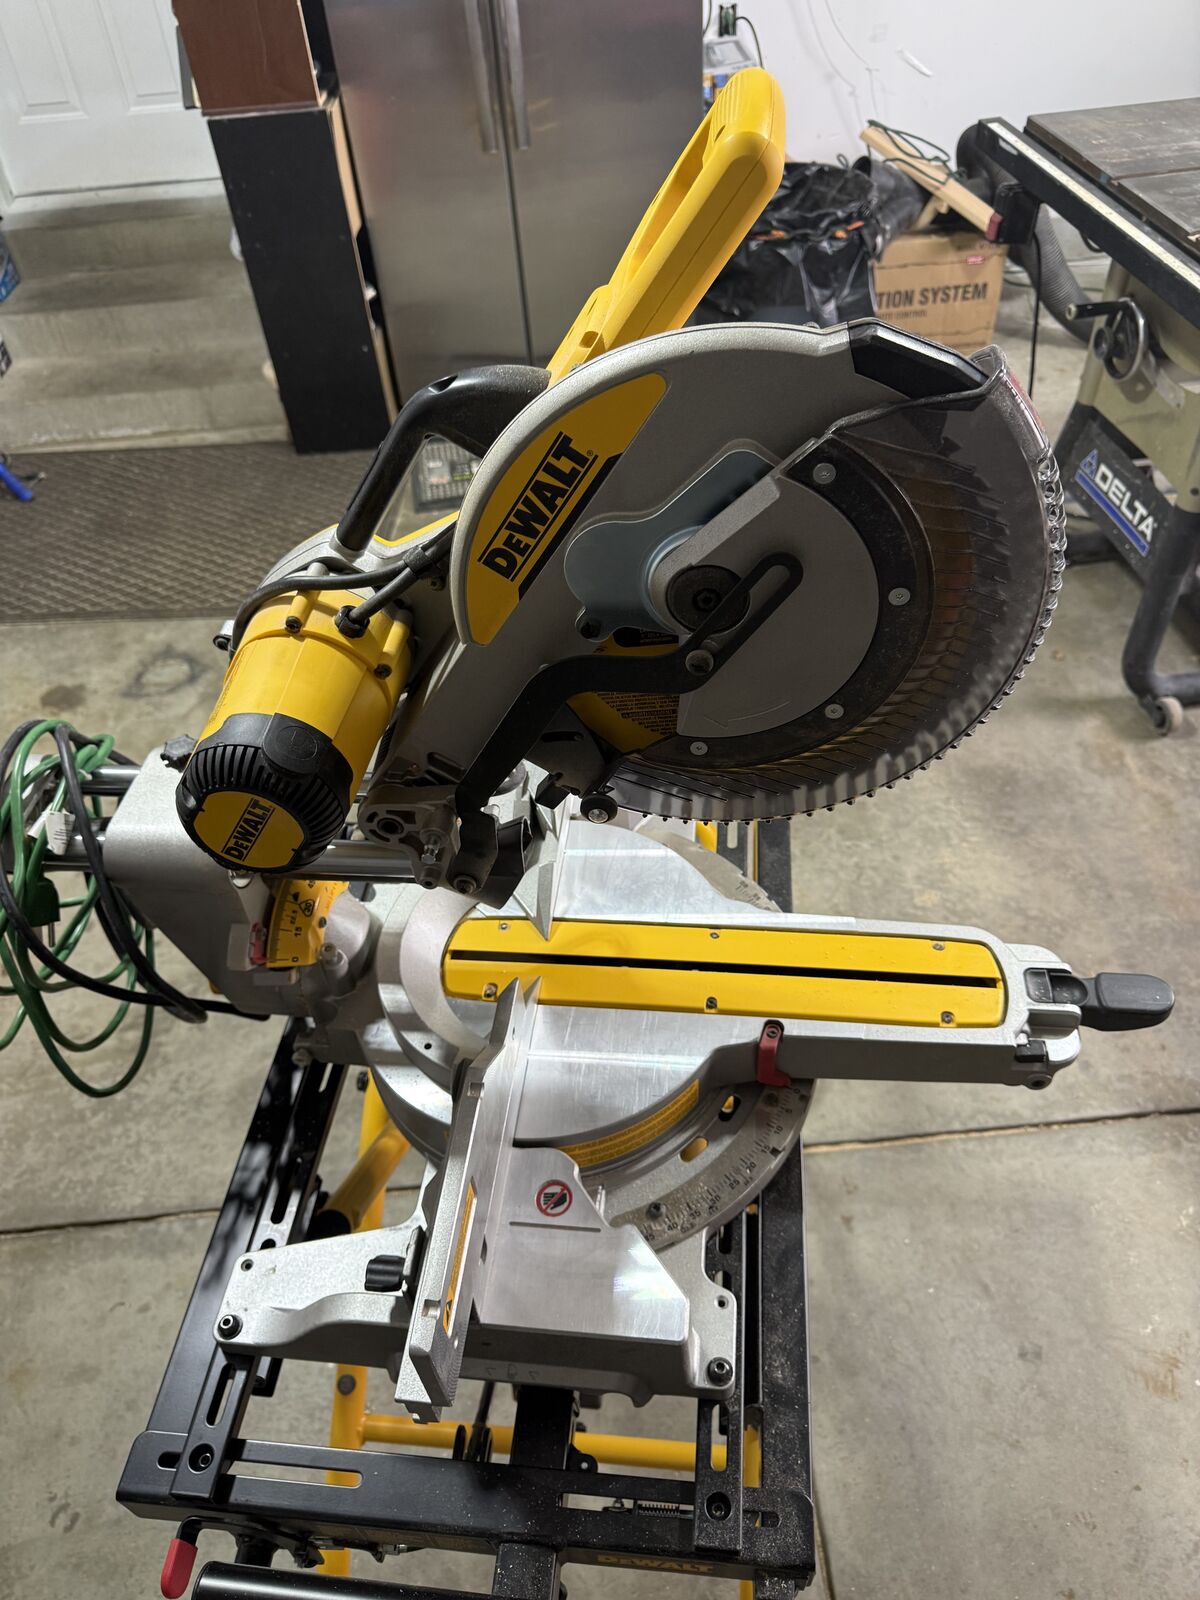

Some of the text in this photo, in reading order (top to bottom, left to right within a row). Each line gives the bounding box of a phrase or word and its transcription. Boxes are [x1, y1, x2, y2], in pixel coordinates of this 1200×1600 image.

[919, 283, 988, 305] SYSTEM
[481, 434, 591, 580] DEWALT
[1094, 462, 1154, 543] DELTA
[223, 799, 272, 861] DEWALT
[773, 1125, 784, 1135] 10
